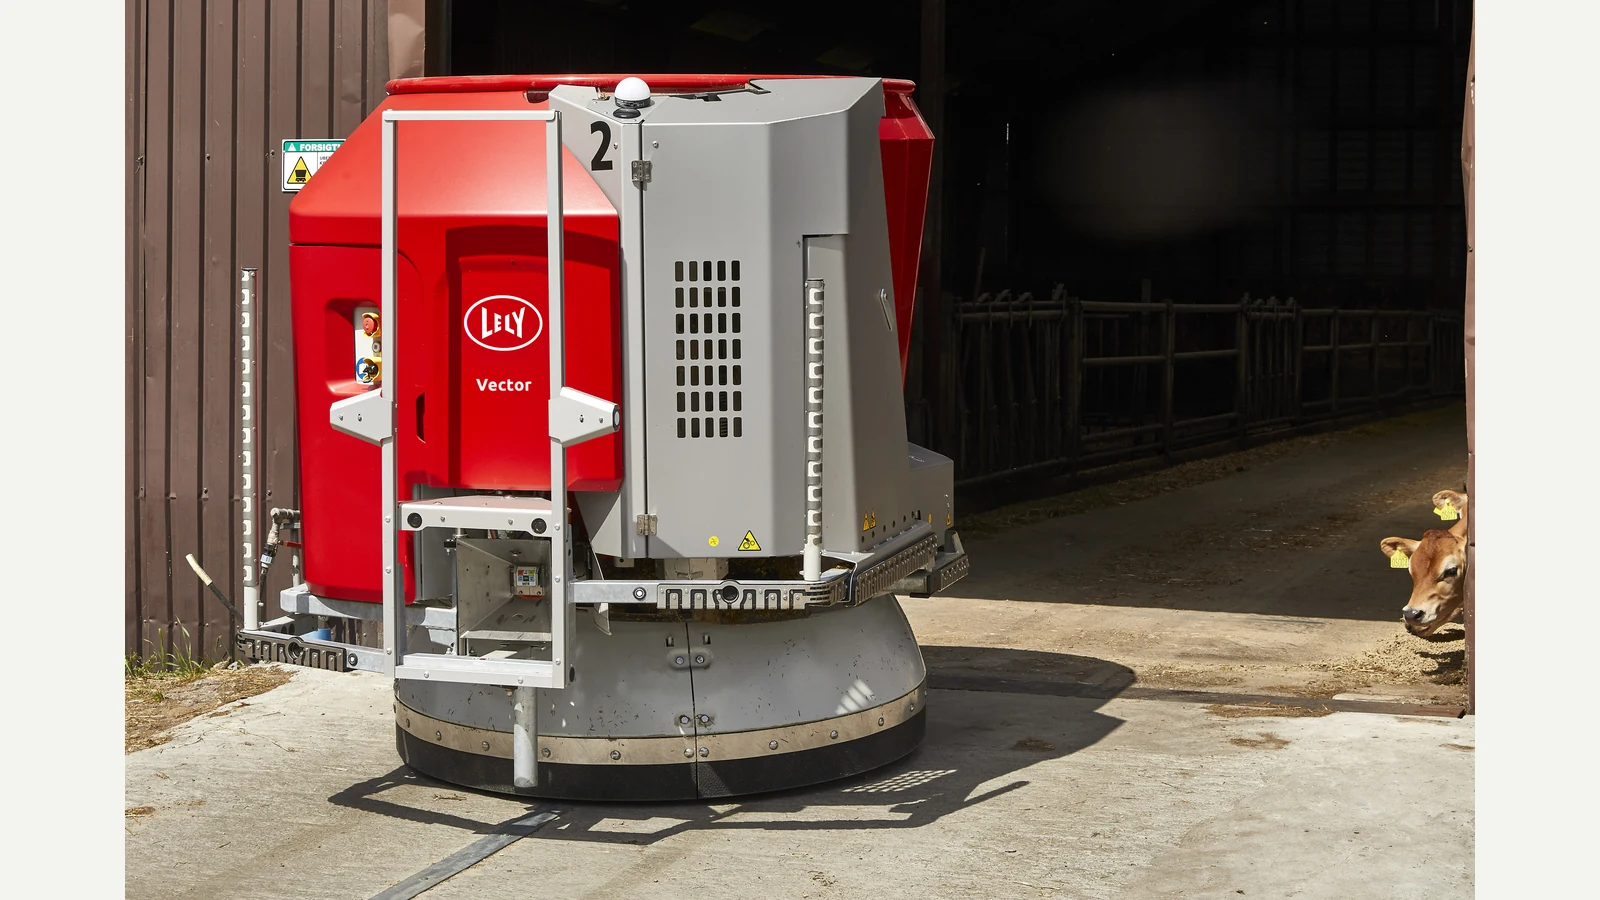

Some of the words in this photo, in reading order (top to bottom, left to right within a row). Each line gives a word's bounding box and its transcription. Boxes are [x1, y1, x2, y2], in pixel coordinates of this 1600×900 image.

[590, 120, 613, 171] 2
[481, 306, 526, 339] LELY
[475, 378, 532, 391] Vector
